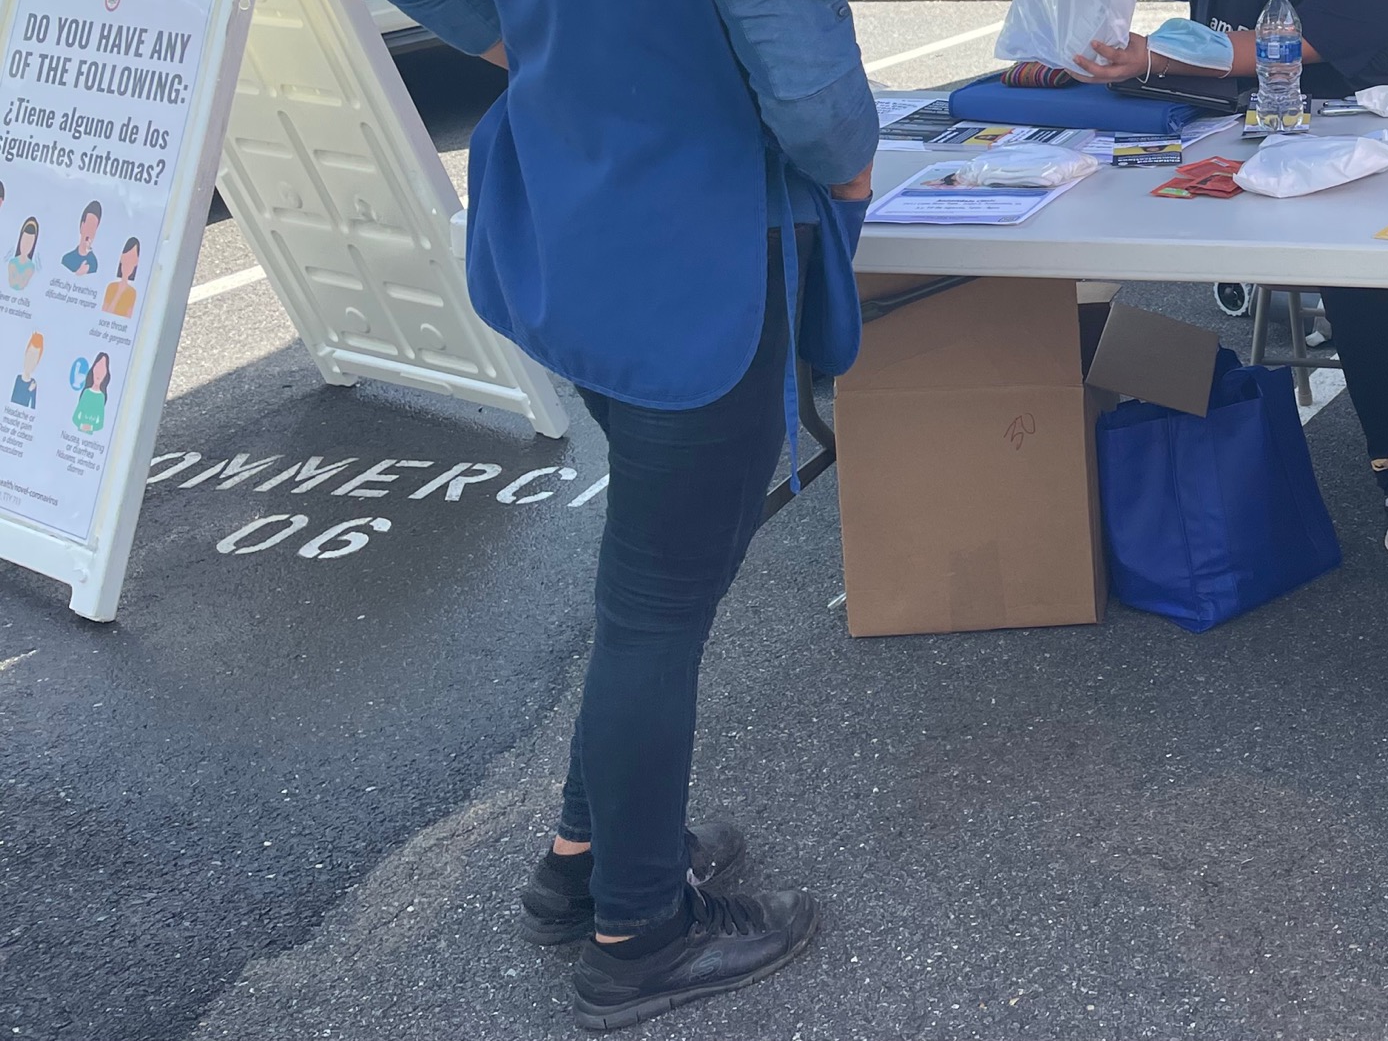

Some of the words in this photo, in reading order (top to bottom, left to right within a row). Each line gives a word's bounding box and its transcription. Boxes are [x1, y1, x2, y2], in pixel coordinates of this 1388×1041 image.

[23, 13, 51, 43] DO
[55, 17, 94, 50] YOU
[96, 23, 148, 58] HAVE
[149, 30, 192, 64] ANY
[8, 49, 33, 80] OF
[36, 53, 72, 87] THE
[73, 59, 189, 105] FOLLOWING:
[3, 97, 55, 129] ¿Tiene
[59, 107, 114, 140] alguno
[118, 116, 139, 144] de
[143, 120, 170, 150] los
[78, 145, 166, 186] síntomas?
[146, 451, 609, 507] OMMERCI
[216, 514, 393, 559] 06
